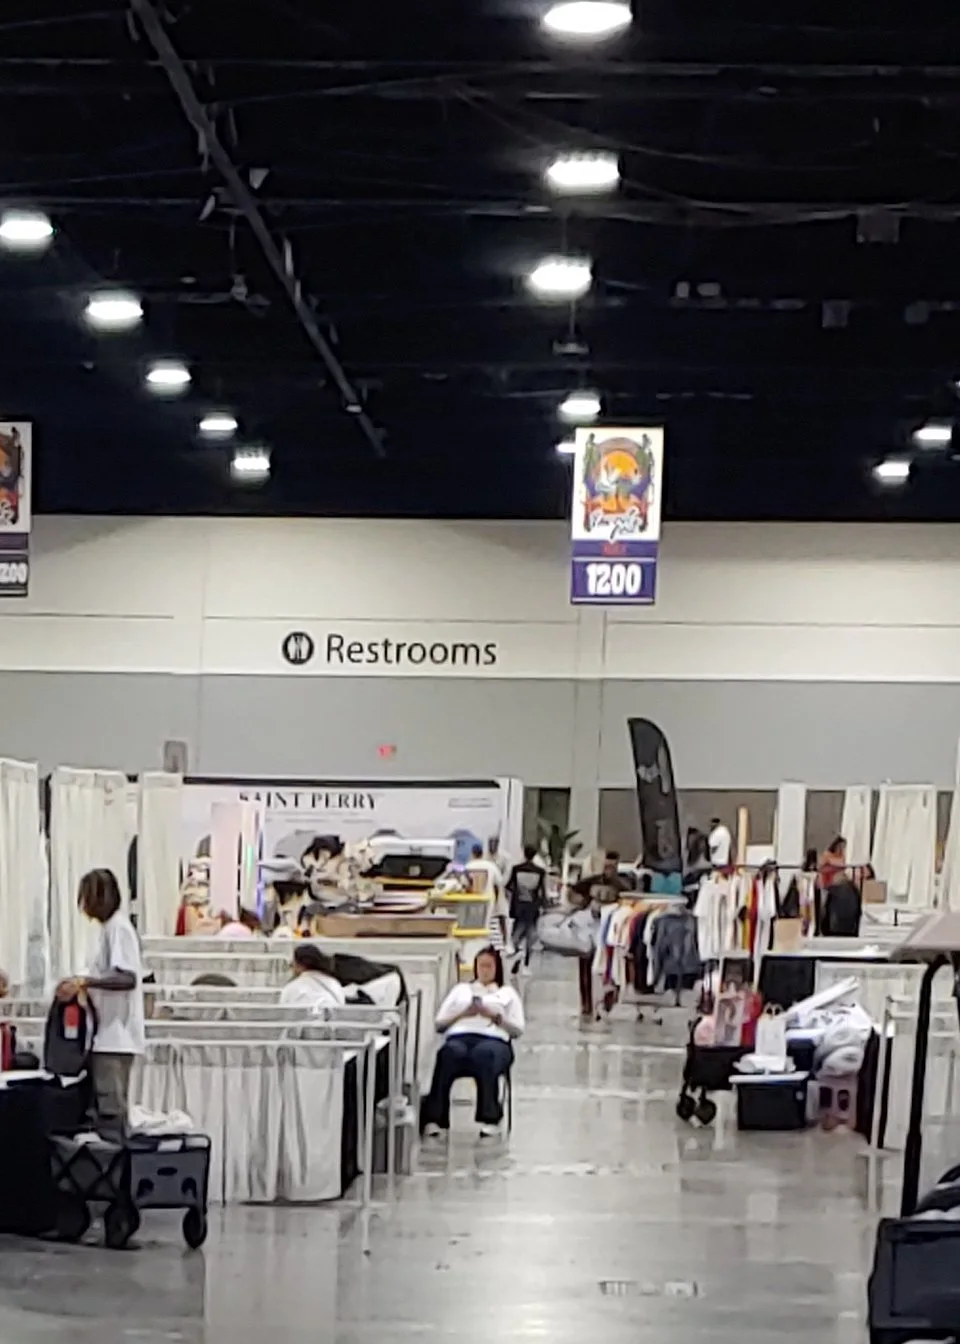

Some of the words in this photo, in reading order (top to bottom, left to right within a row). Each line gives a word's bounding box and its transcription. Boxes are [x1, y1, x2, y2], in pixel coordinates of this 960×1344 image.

[586, 563, 642, 595] 1200
[326, 633, 497, 665] Restrooms
[311, 792, 381, 810] PERRY
